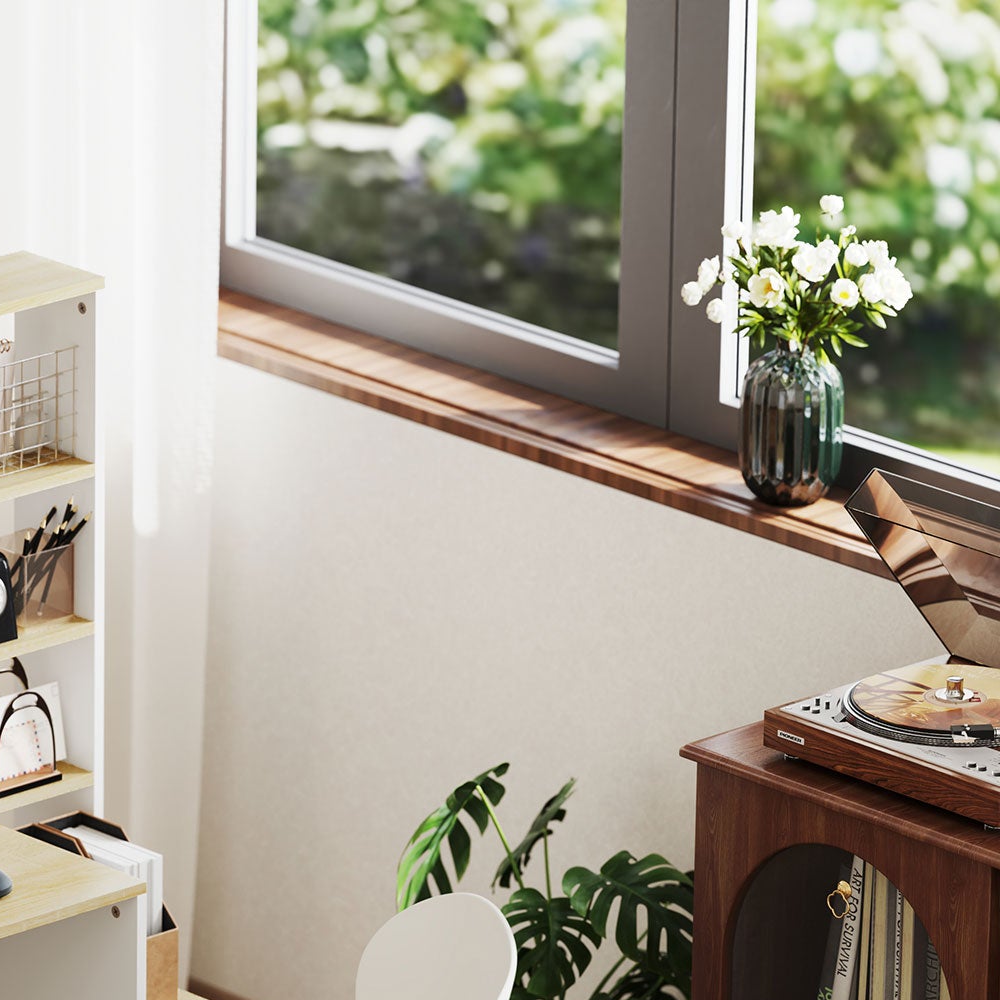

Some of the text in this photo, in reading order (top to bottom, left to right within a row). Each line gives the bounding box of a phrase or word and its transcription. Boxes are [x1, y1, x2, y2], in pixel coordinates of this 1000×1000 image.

[837, 868, 863, 978] ART FOR SURVIVAL
